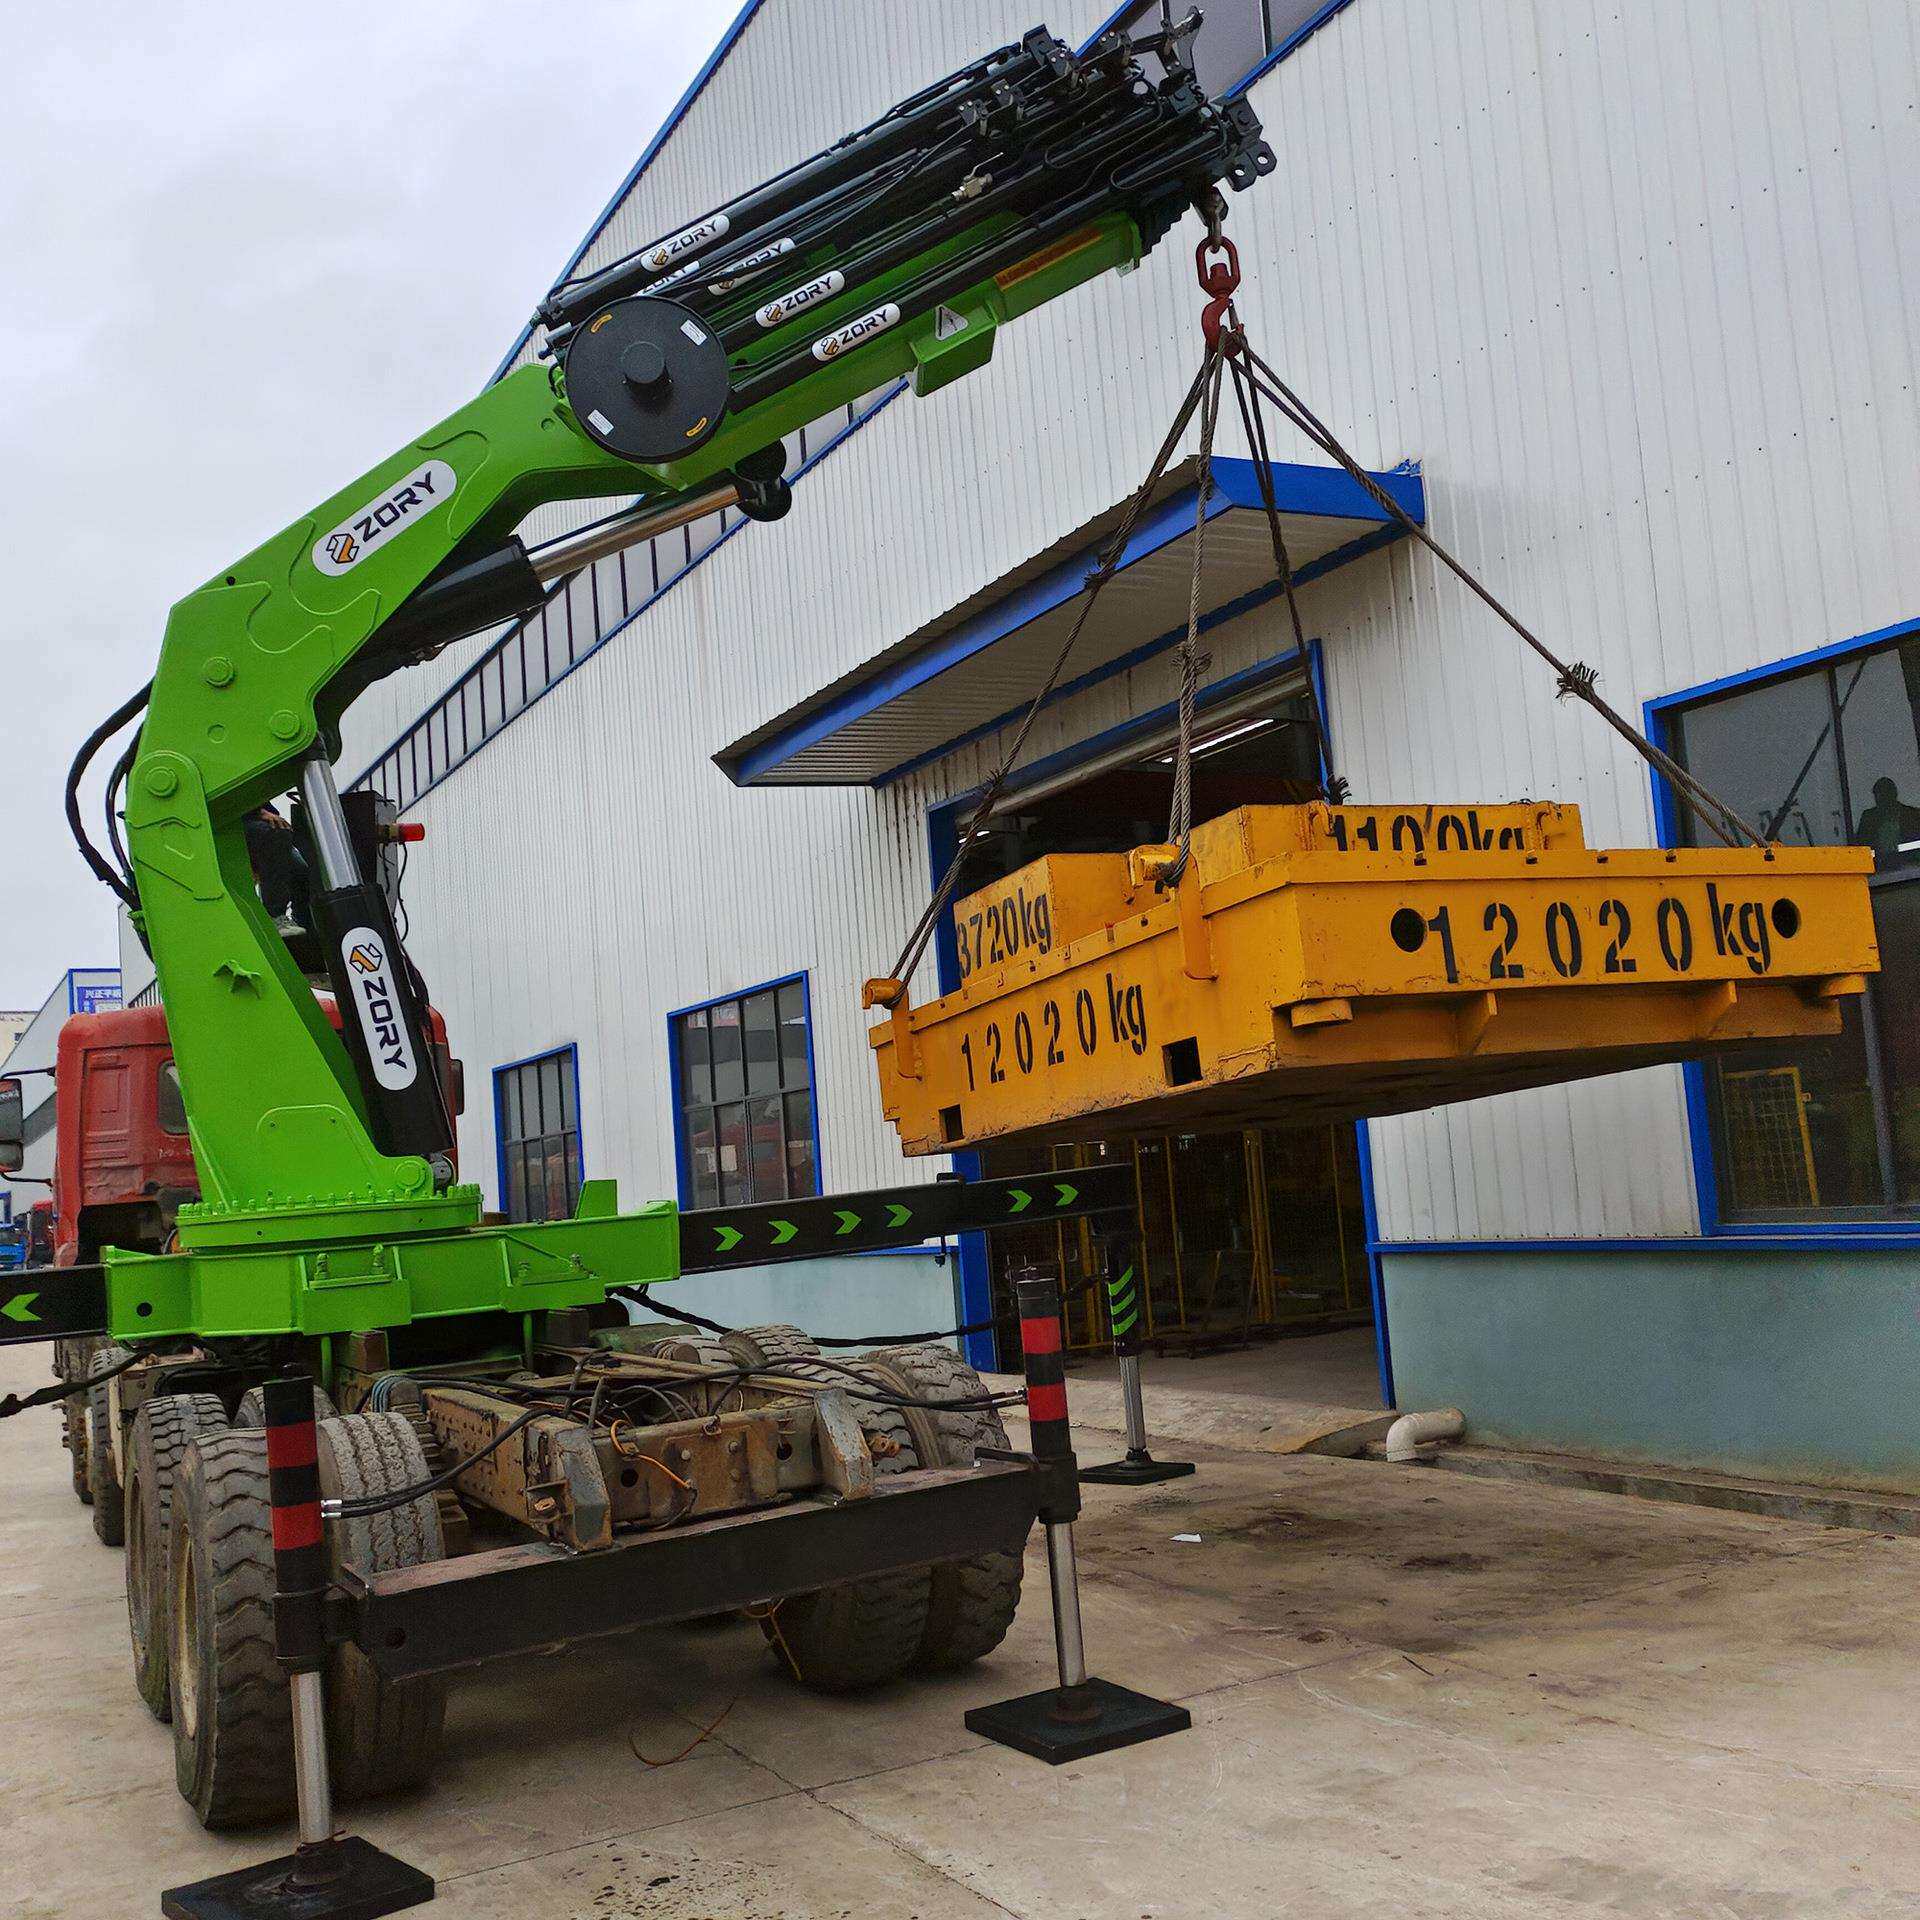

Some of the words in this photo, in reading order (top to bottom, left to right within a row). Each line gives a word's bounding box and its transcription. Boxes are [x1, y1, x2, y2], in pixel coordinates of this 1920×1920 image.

[669, 220, 717, 254] ZORY
[733, 243, 781, 271] ORY
[782, 276, 832, 311] ZORY
[838, 308, 888, 345] ZORY
[353, 471, 435, 543] ZORY
[363, 976, 407, 1069] ZORY
